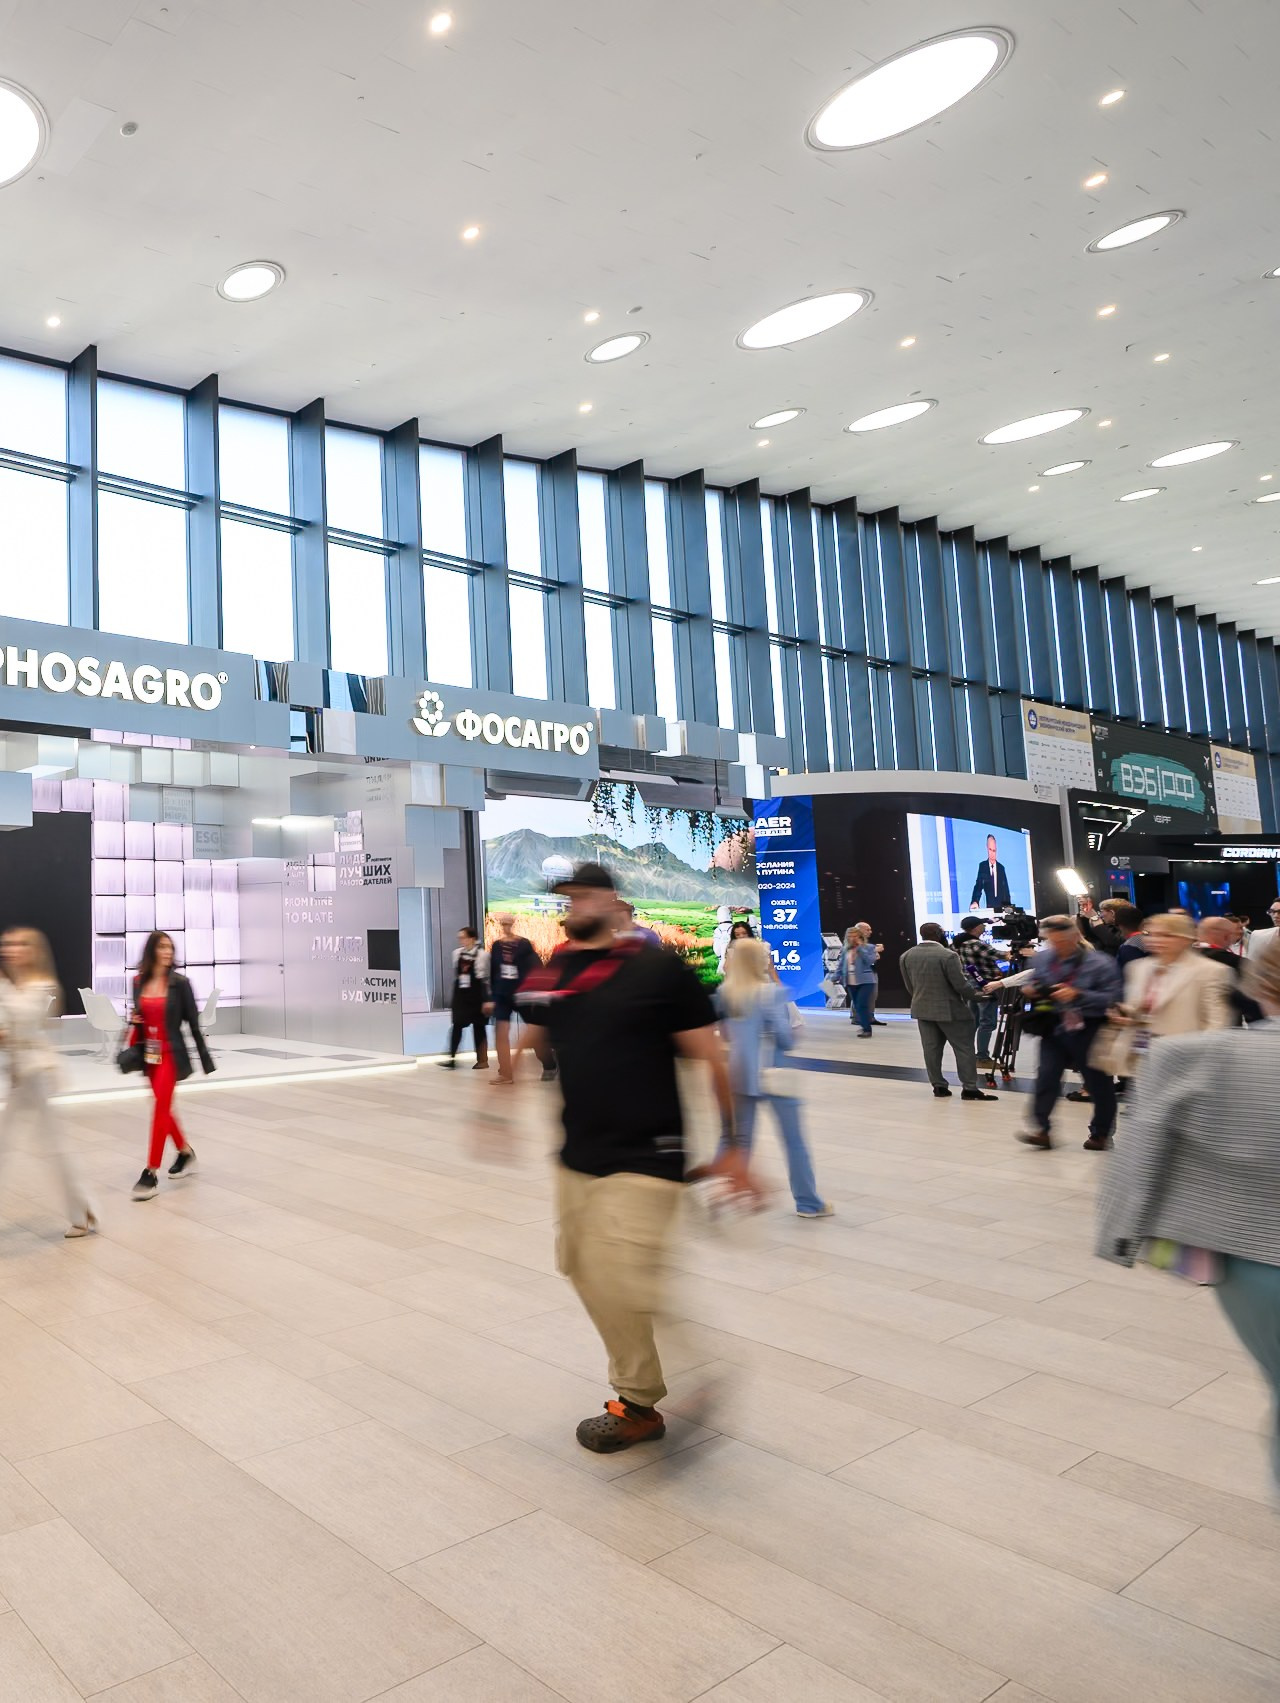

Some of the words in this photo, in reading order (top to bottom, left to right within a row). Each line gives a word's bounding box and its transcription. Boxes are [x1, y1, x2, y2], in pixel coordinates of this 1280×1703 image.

[455, 709, 590, 756] ФОСАГРО
[195, 831, 220, 844] ESG
[340, 853, 371, 865] ЛИДЕР
[339, 864, 391, 879] ЛУЧШИХ
[762, 868, 795, 876] ПУТИНА
[340, 877, 393, 887] РАБОТОДАТЕЛЕЙ
[284, 896, 309, 907] FROM
[285, 911, 300, 923] TO
[301, 911, 334, 924] PLATE
[772, 908, 798, 923] 37
[770, 949, 801, 966] 1,6
